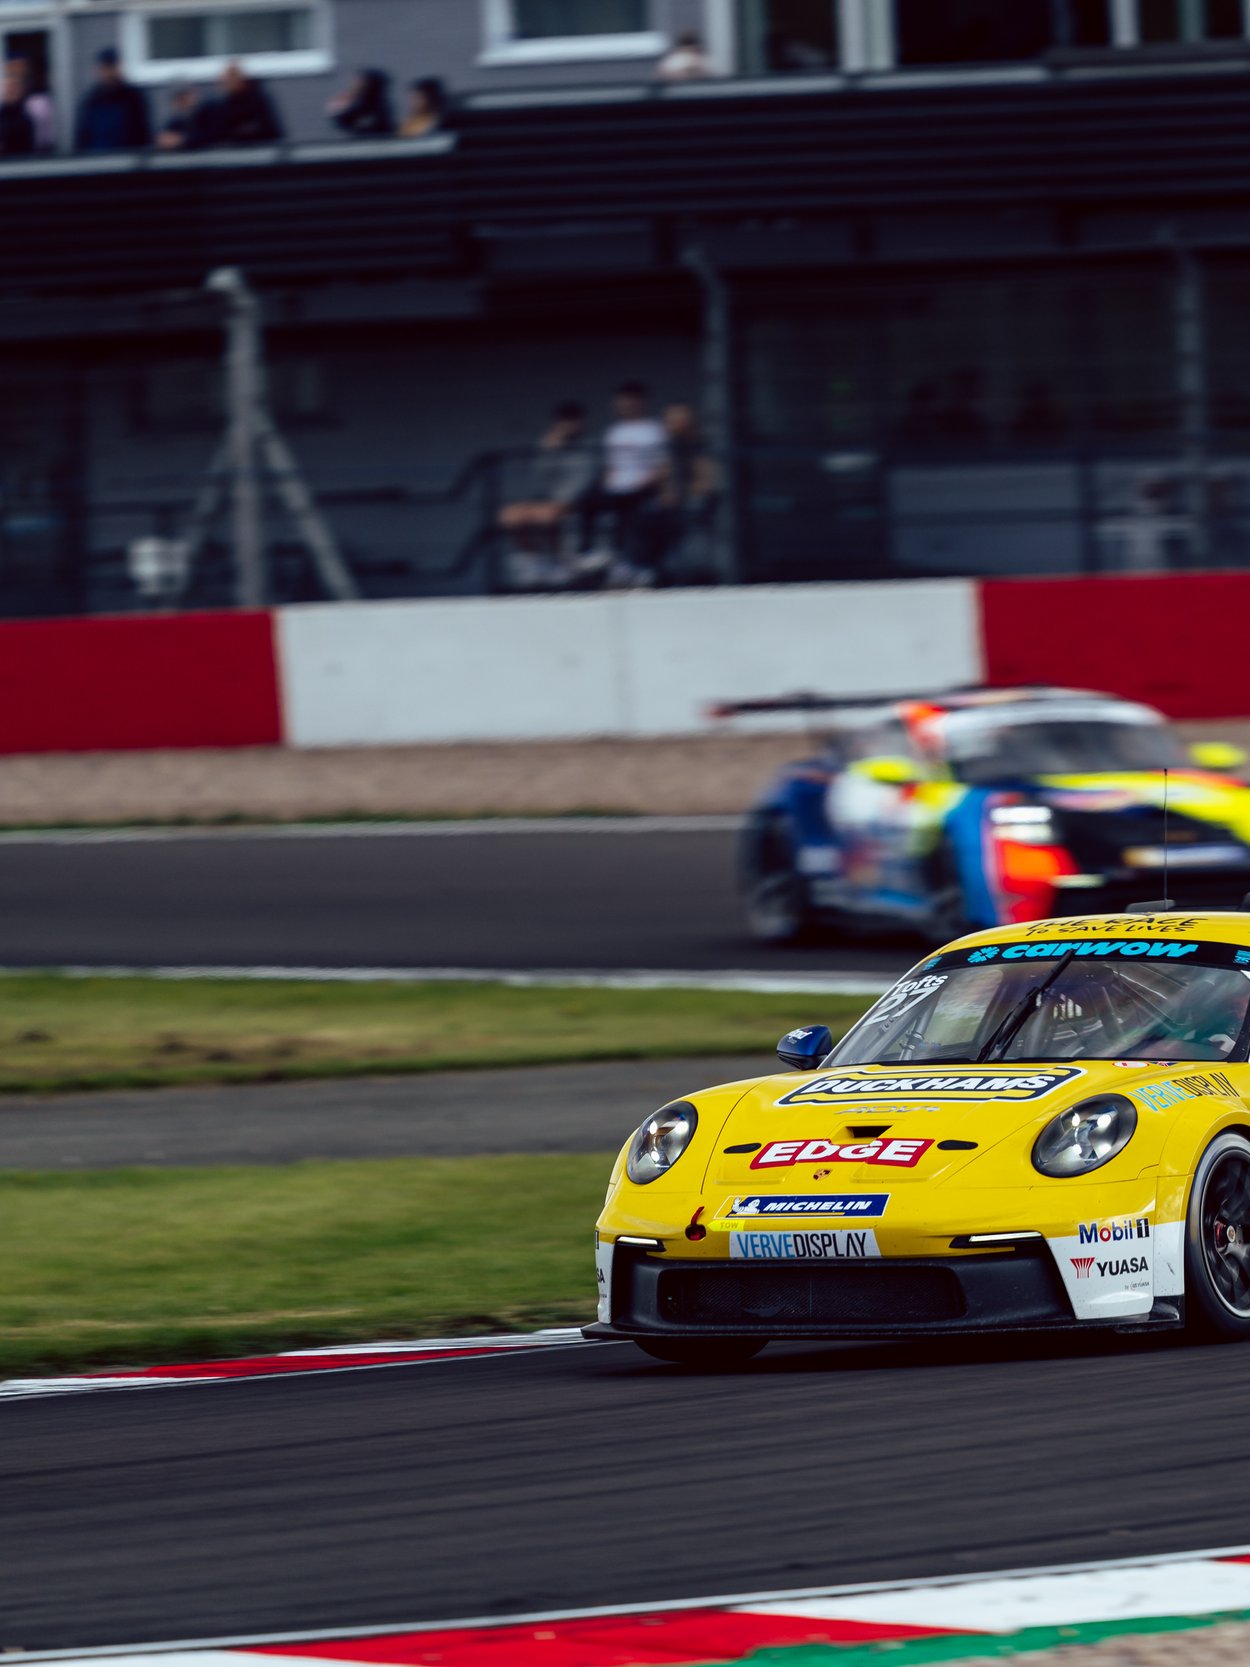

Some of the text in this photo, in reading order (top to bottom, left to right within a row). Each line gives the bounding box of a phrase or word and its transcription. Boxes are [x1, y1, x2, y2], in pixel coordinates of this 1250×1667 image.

[1027, 917, 1207, 930] THE RACE
[1058, 924, 1118, 933] SAVE
[1125, 924, 1190, 933] LIVES
[1001, 941, 1198, 958] carwow
[891, 975, 948, 995] Tofts
[863, 985, 940, 1027] 27
[802, 1074, 1055, 1093] DUCKHAMS
[1127, 1072, 1240, 1112] VERVEDISPLAY
[759, 1140, 925, 1163] EDGE
[763, 1201, 872, 1211] MICHELIN
[1079, 1219, 1133, 1244] Mobil
[736, 1232, 867, 1258] VERVEDISPLAY
[1097, 1256, 1149, 1277] YUASA
